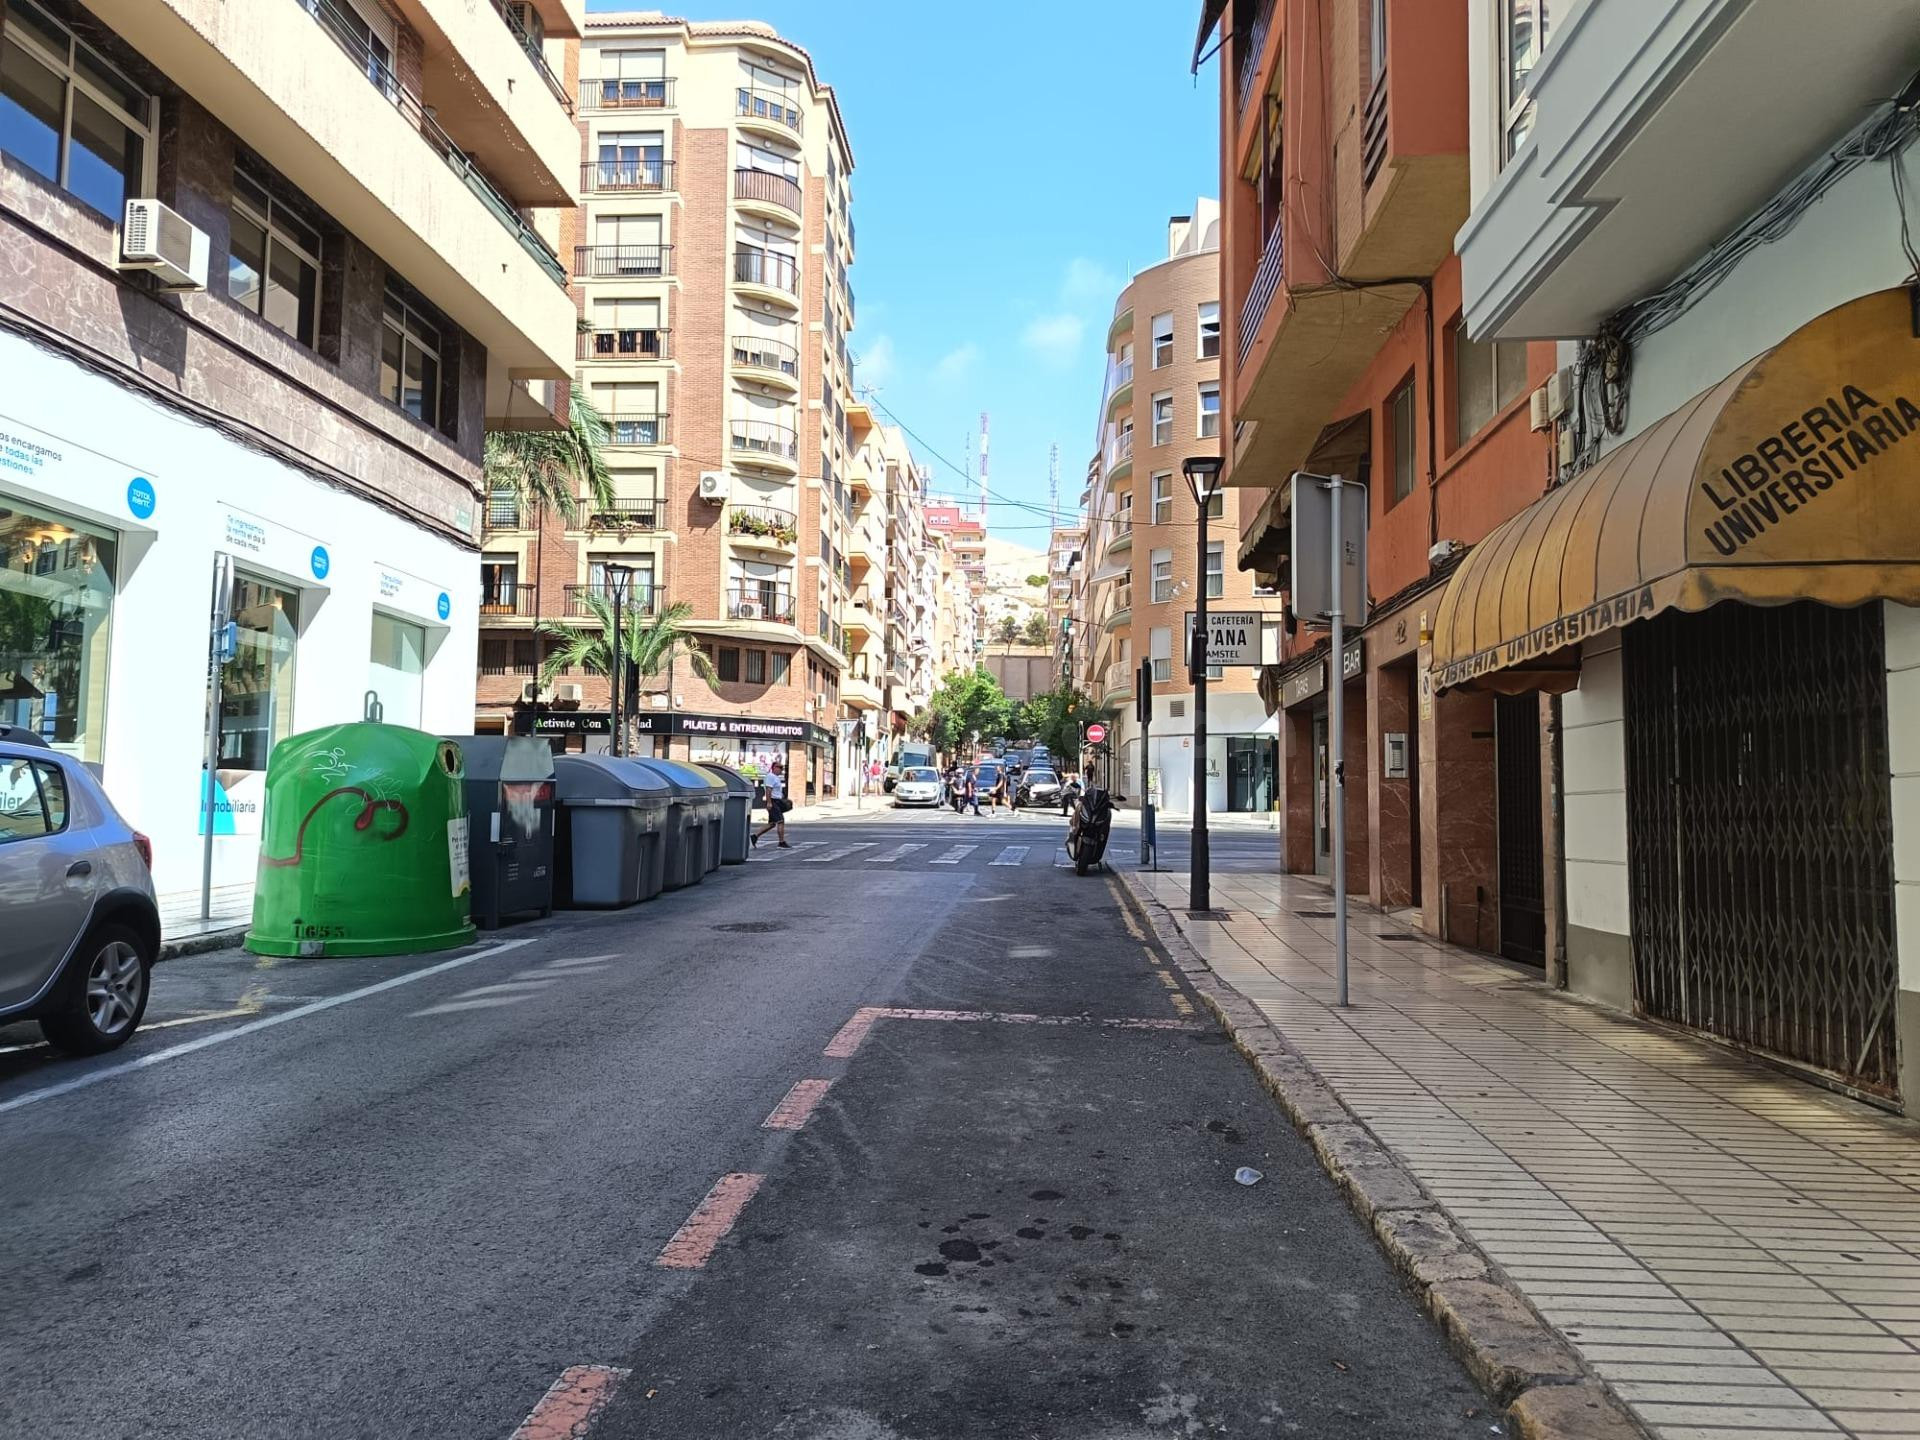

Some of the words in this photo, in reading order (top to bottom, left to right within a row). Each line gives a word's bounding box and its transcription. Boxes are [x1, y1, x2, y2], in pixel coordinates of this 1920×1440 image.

[5, 446, 30, 461] todas
[31, 454, 44, 467] las
[11, 436, 63, 462] encargamos
[1701, 385, 1879, 511] LIBRERIA
[1704, 397, 1920, 556] UNIVERSITARIA
[1211, 615, 1254, 626] CAFETERÍA
[1437, 651, 1499, 686] LIBRERIA
[1507, 587, 1655, 662] UNIVERSITARIA
[1206, 650, 1240, 658] AMSTEL
[1343, 649, 1360, 674] BAR
[536, 718, 575, 729] Activate
[582, 718, 602, 729] Con
[683, 719, 717, 731] PILATES
[720, 721, 727, 732] &
[729, 722, 803, 736] ENTRENAMIENTOS
